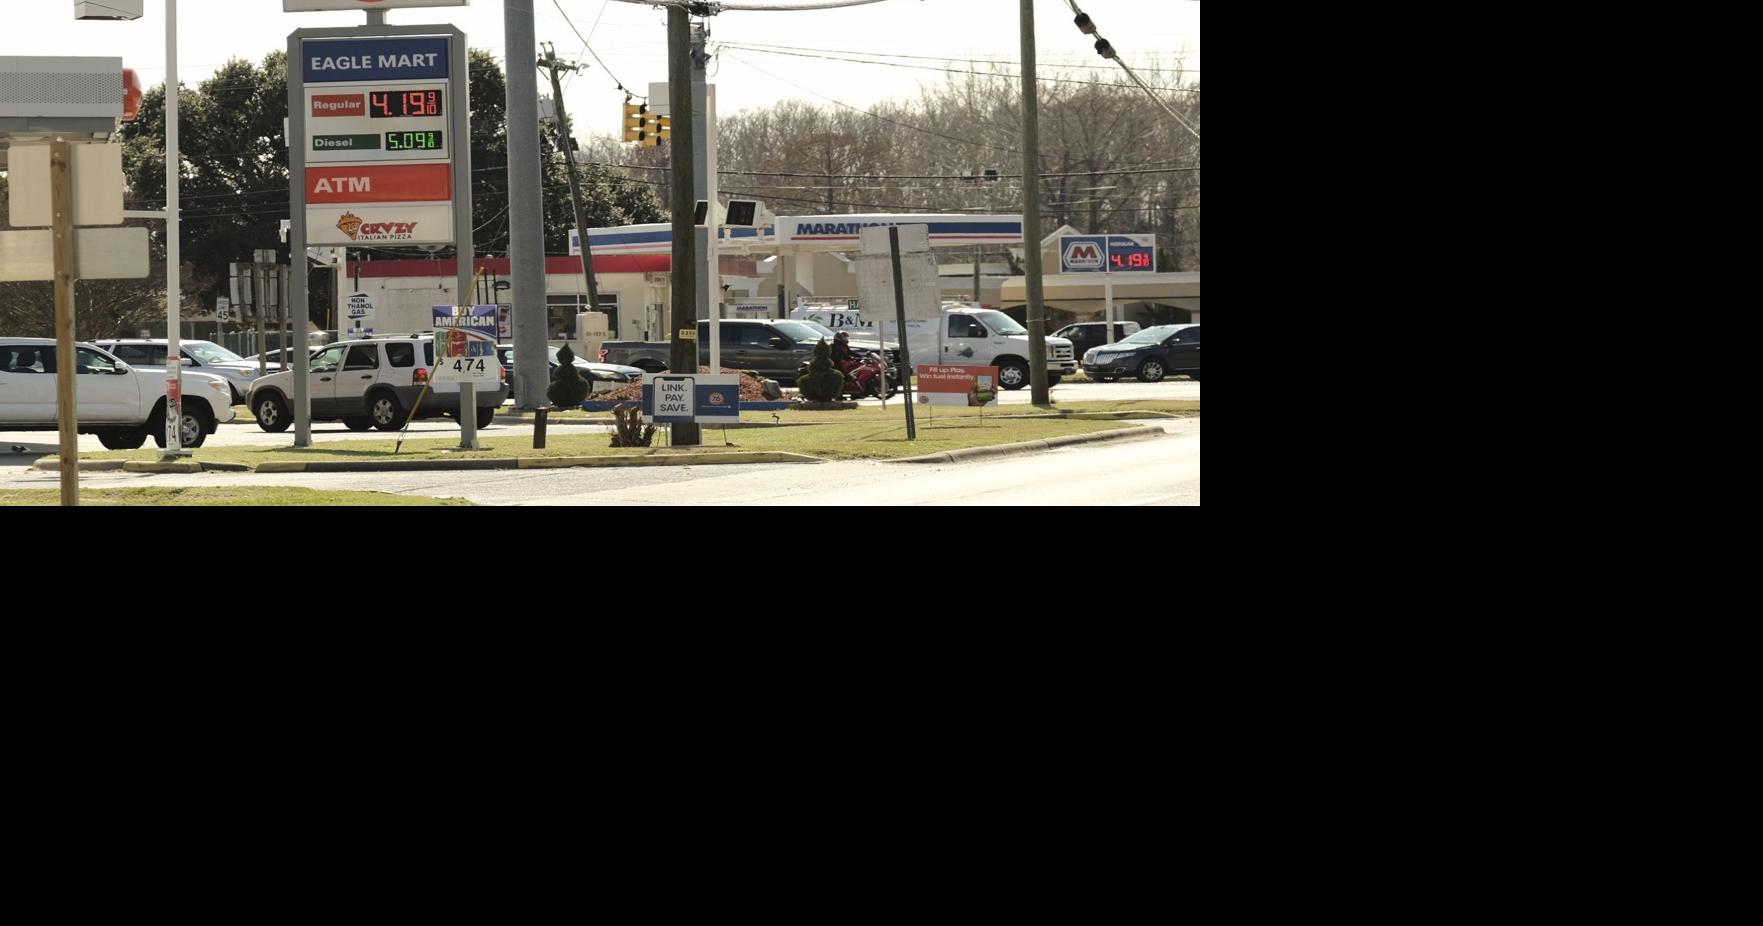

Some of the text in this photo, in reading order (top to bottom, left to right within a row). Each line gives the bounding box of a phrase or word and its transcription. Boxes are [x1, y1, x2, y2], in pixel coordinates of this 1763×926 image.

[311, 53, 437, 70] EAGLE MART
[313, 100, 361, 111] Regular
[372, 92, 425, 115] 4.19
[314, 137, 353, 147] Diesel
[388, 132, 426, 149] 5.09
[313, 176, 371, 193] ATM
[1071, 246, 1098, 258] M
[217, 310, 229, 320] 45
[435, 316, 495, 327] AMERICAN
[661, 383, 688, 392] LINK.
[665, 393, 685, 402] PAY.
[660, 403, 689, 412] SAVE.
